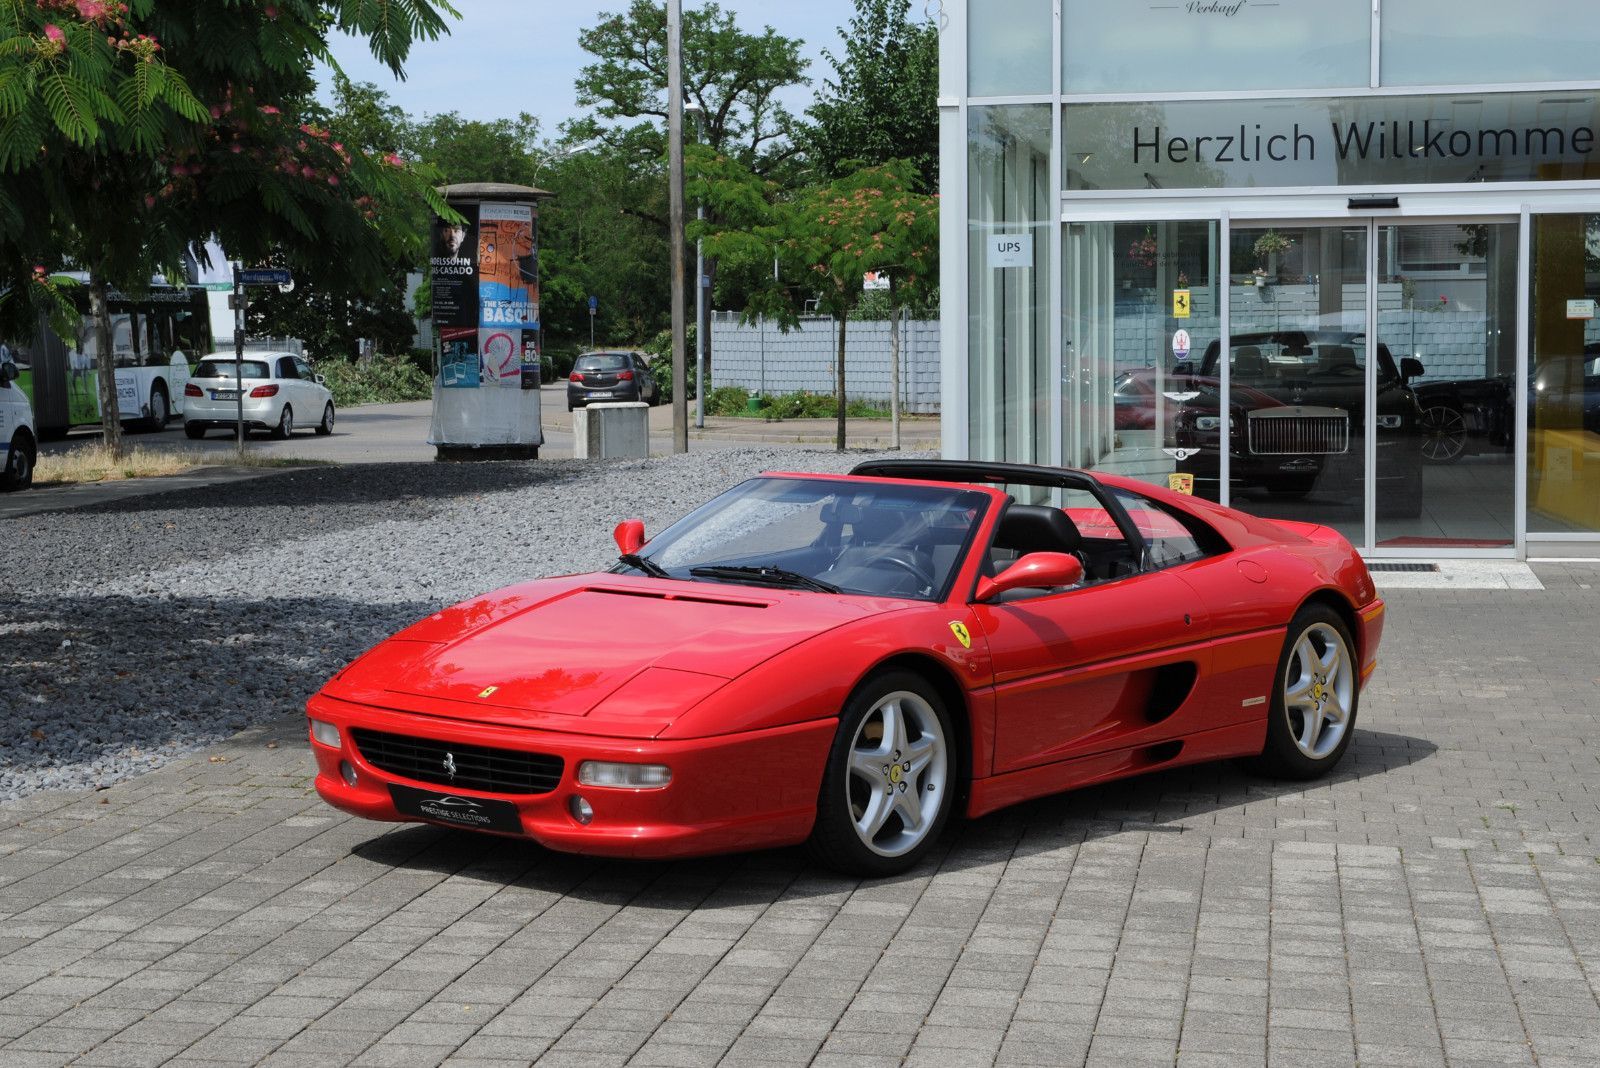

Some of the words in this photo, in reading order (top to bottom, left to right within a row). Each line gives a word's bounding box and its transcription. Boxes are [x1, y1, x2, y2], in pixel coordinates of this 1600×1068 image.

[1185, 0, 1247, 17] Verkauf
[1133, 123, 1315, 164] Herzlich
[1331, 119, 1595, 160] Willkomme
[997, 242, 1021, 253] UPS
[420, 805, 450, 818] PRESTIGE
[450, 810, 491, 824] SELECTIONS
